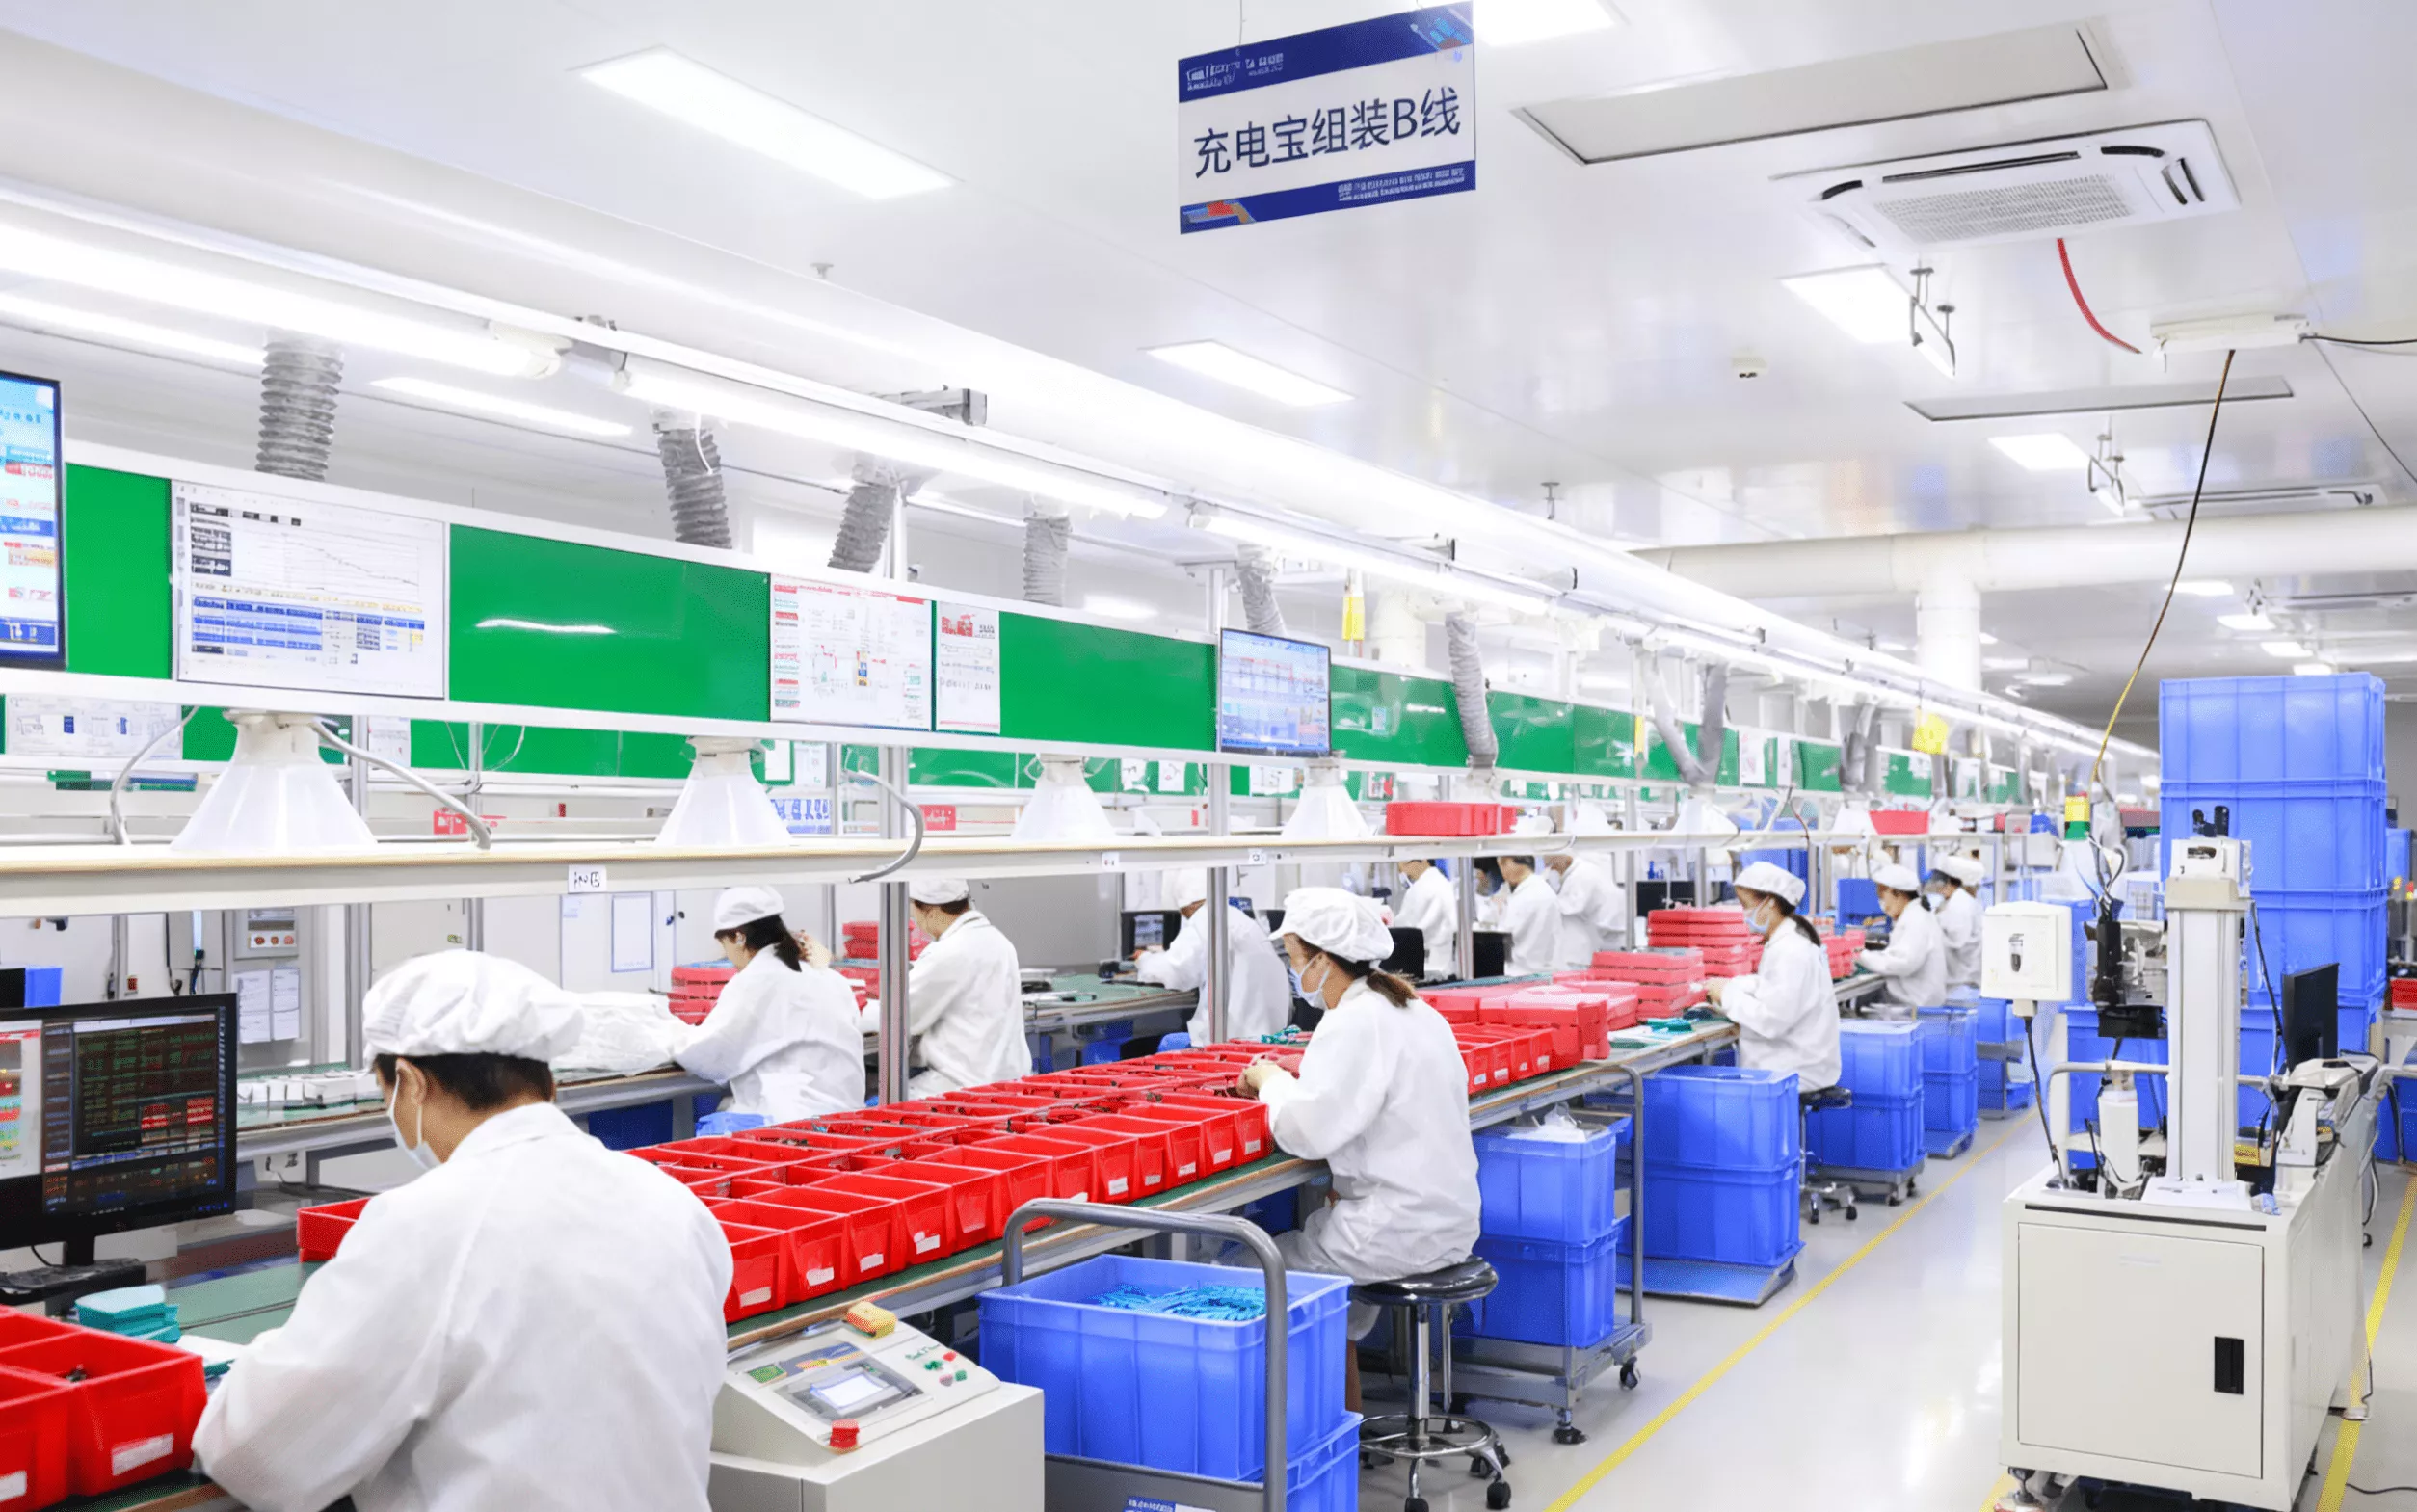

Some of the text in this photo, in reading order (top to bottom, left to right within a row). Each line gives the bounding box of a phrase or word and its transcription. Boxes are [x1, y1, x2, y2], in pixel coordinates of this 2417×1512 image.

[1194, 87, 1460, 178] 充电宝组装B线
